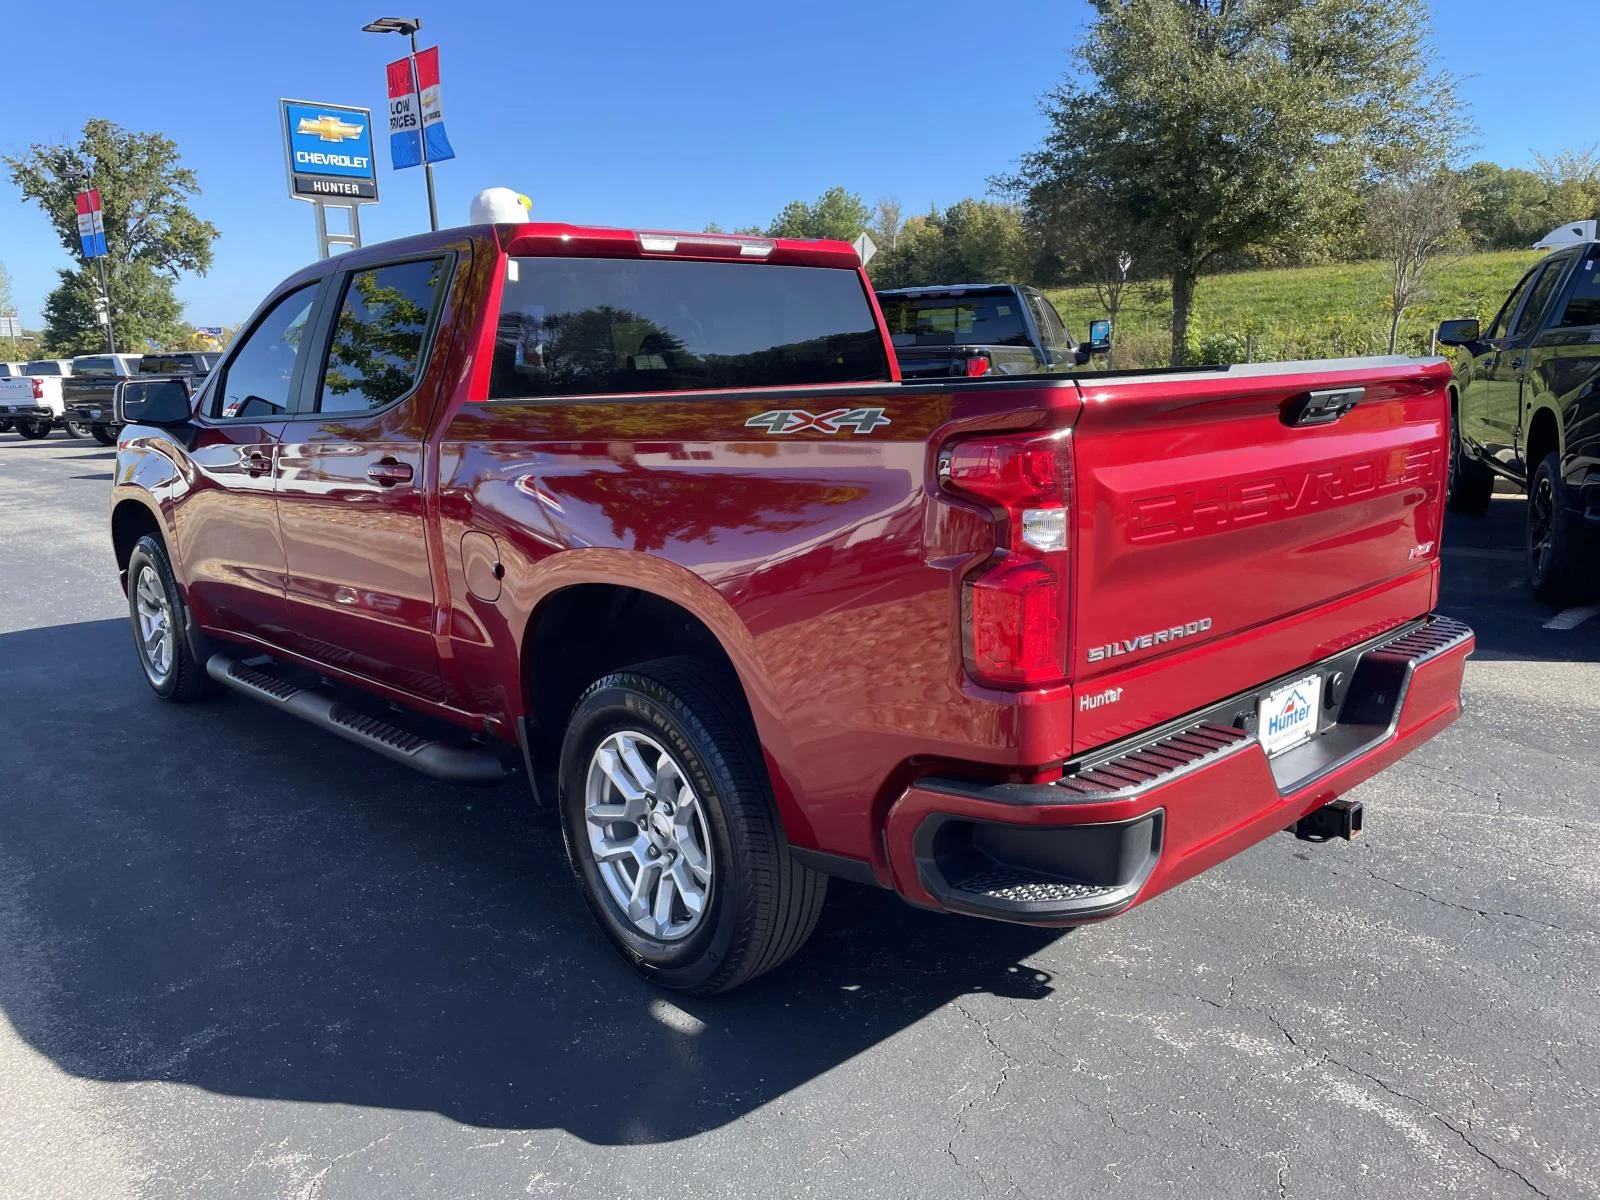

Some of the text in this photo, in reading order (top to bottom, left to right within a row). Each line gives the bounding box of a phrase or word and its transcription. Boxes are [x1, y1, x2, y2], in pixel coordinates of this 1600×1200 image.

[391, 98, 410, 115] LOW
[296, 151, 368, 169] CHEVROLET
[313, 181, 359, 195] HUNTER
[1131, 449, 1441, 540] CHEVROLET
[1087, 617, 1213, 663] SILVERADO
[1080, 687, 1124, 712] Hunter
[1268, 703, 1312, 736] Hunter
[653, 711, 713, 794] MICHELIN
